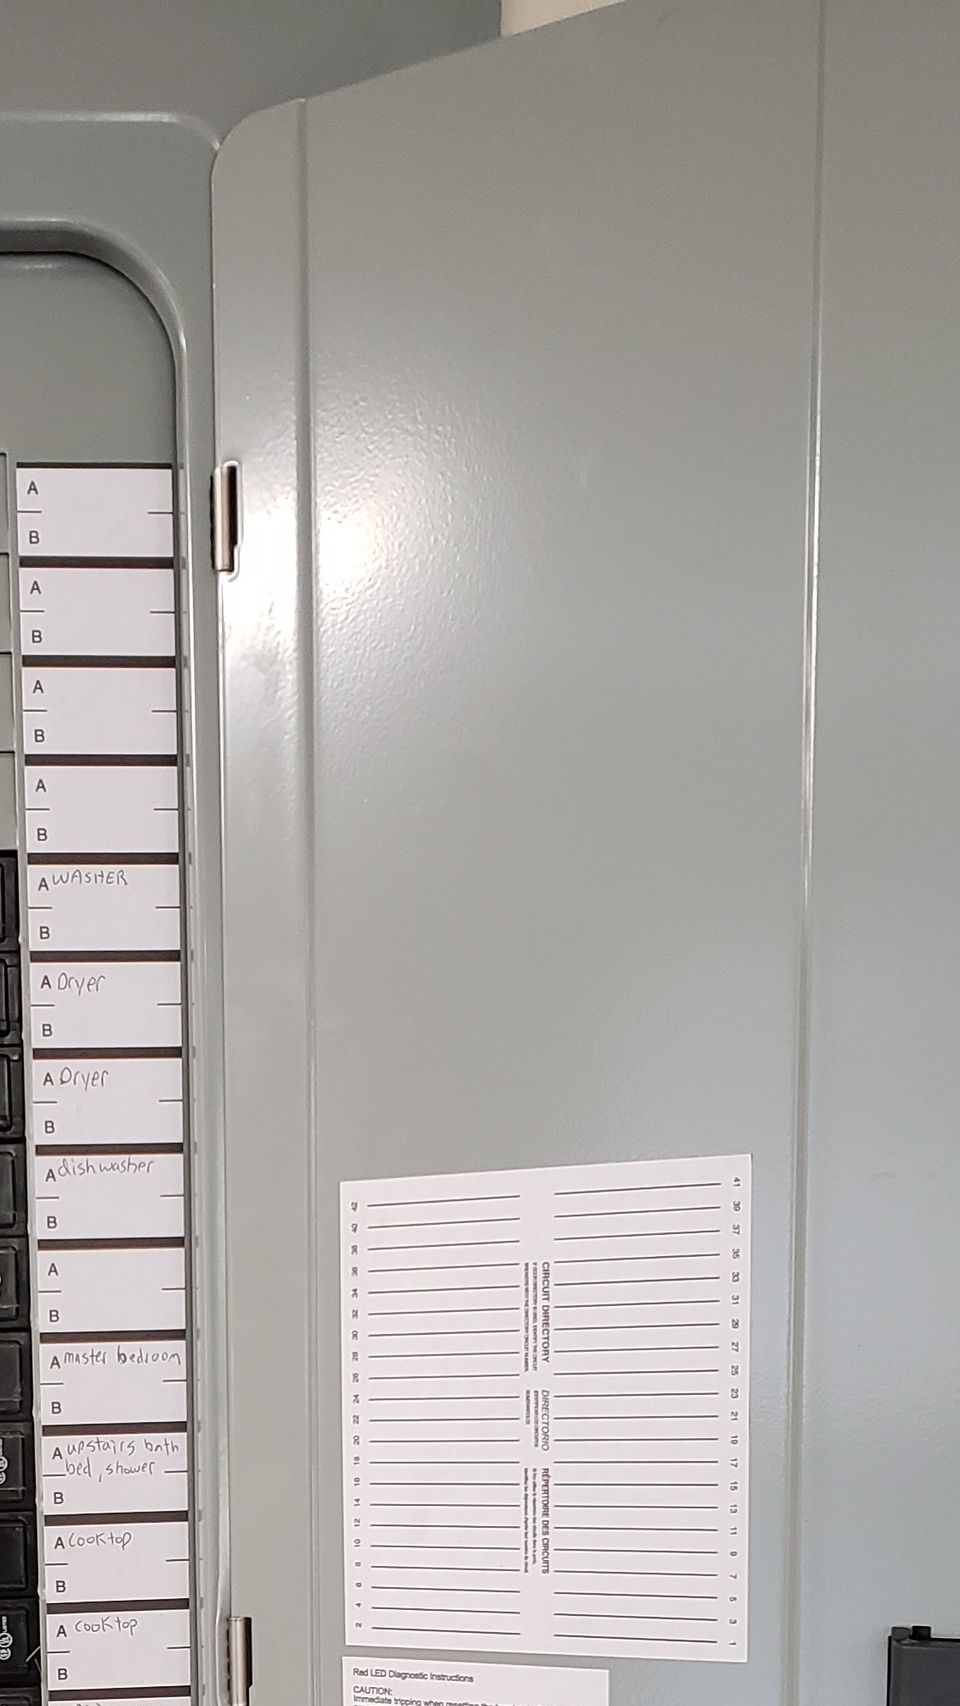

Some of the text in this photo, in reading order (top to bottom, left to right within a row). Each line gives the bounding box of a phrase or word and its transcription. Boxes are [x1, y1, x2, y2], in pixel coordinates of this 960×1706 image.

[27, 480, 39, 495] A
[28, 530, 40, 545] B
[52, 869, 128, 885] WASHER
[58, 972, 105, 994] Dryer
[60, 1067, 108, 1091] Dryer
[542, 1305, 550, 1363] DIRECTORY
[106, 1461, 155, 1475] shower
[353, 1668, 473, 1682] Red LED Diagnostic Instructions
[353, 1686, 392, 1695] CAUTION:
